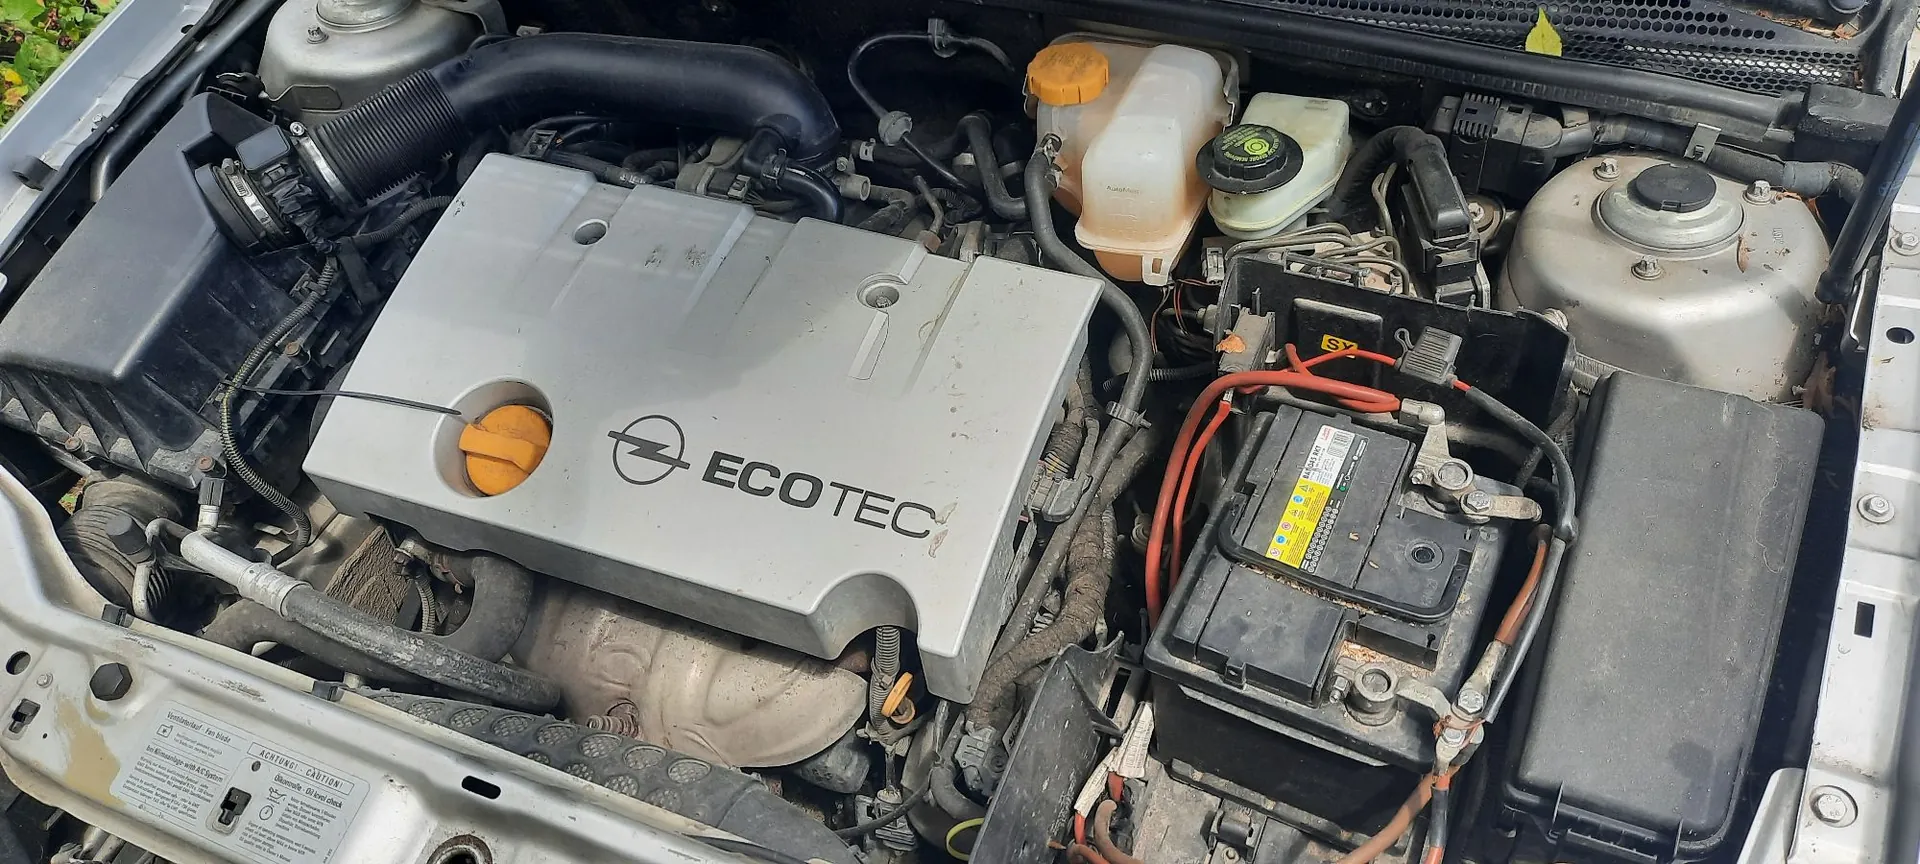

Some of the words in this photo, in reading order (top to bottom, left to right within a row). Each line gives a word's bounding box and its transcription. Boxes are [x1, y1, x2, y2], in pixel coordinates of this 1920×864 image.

[702, 450, 937, 539] ECOTEC
[204, 727, 215, 736] Fan
[204, 769, 223, 783] System
[259, 749, 298, 770] ACHTUNG!
[305, 768, 344, 789] CAUTION!
